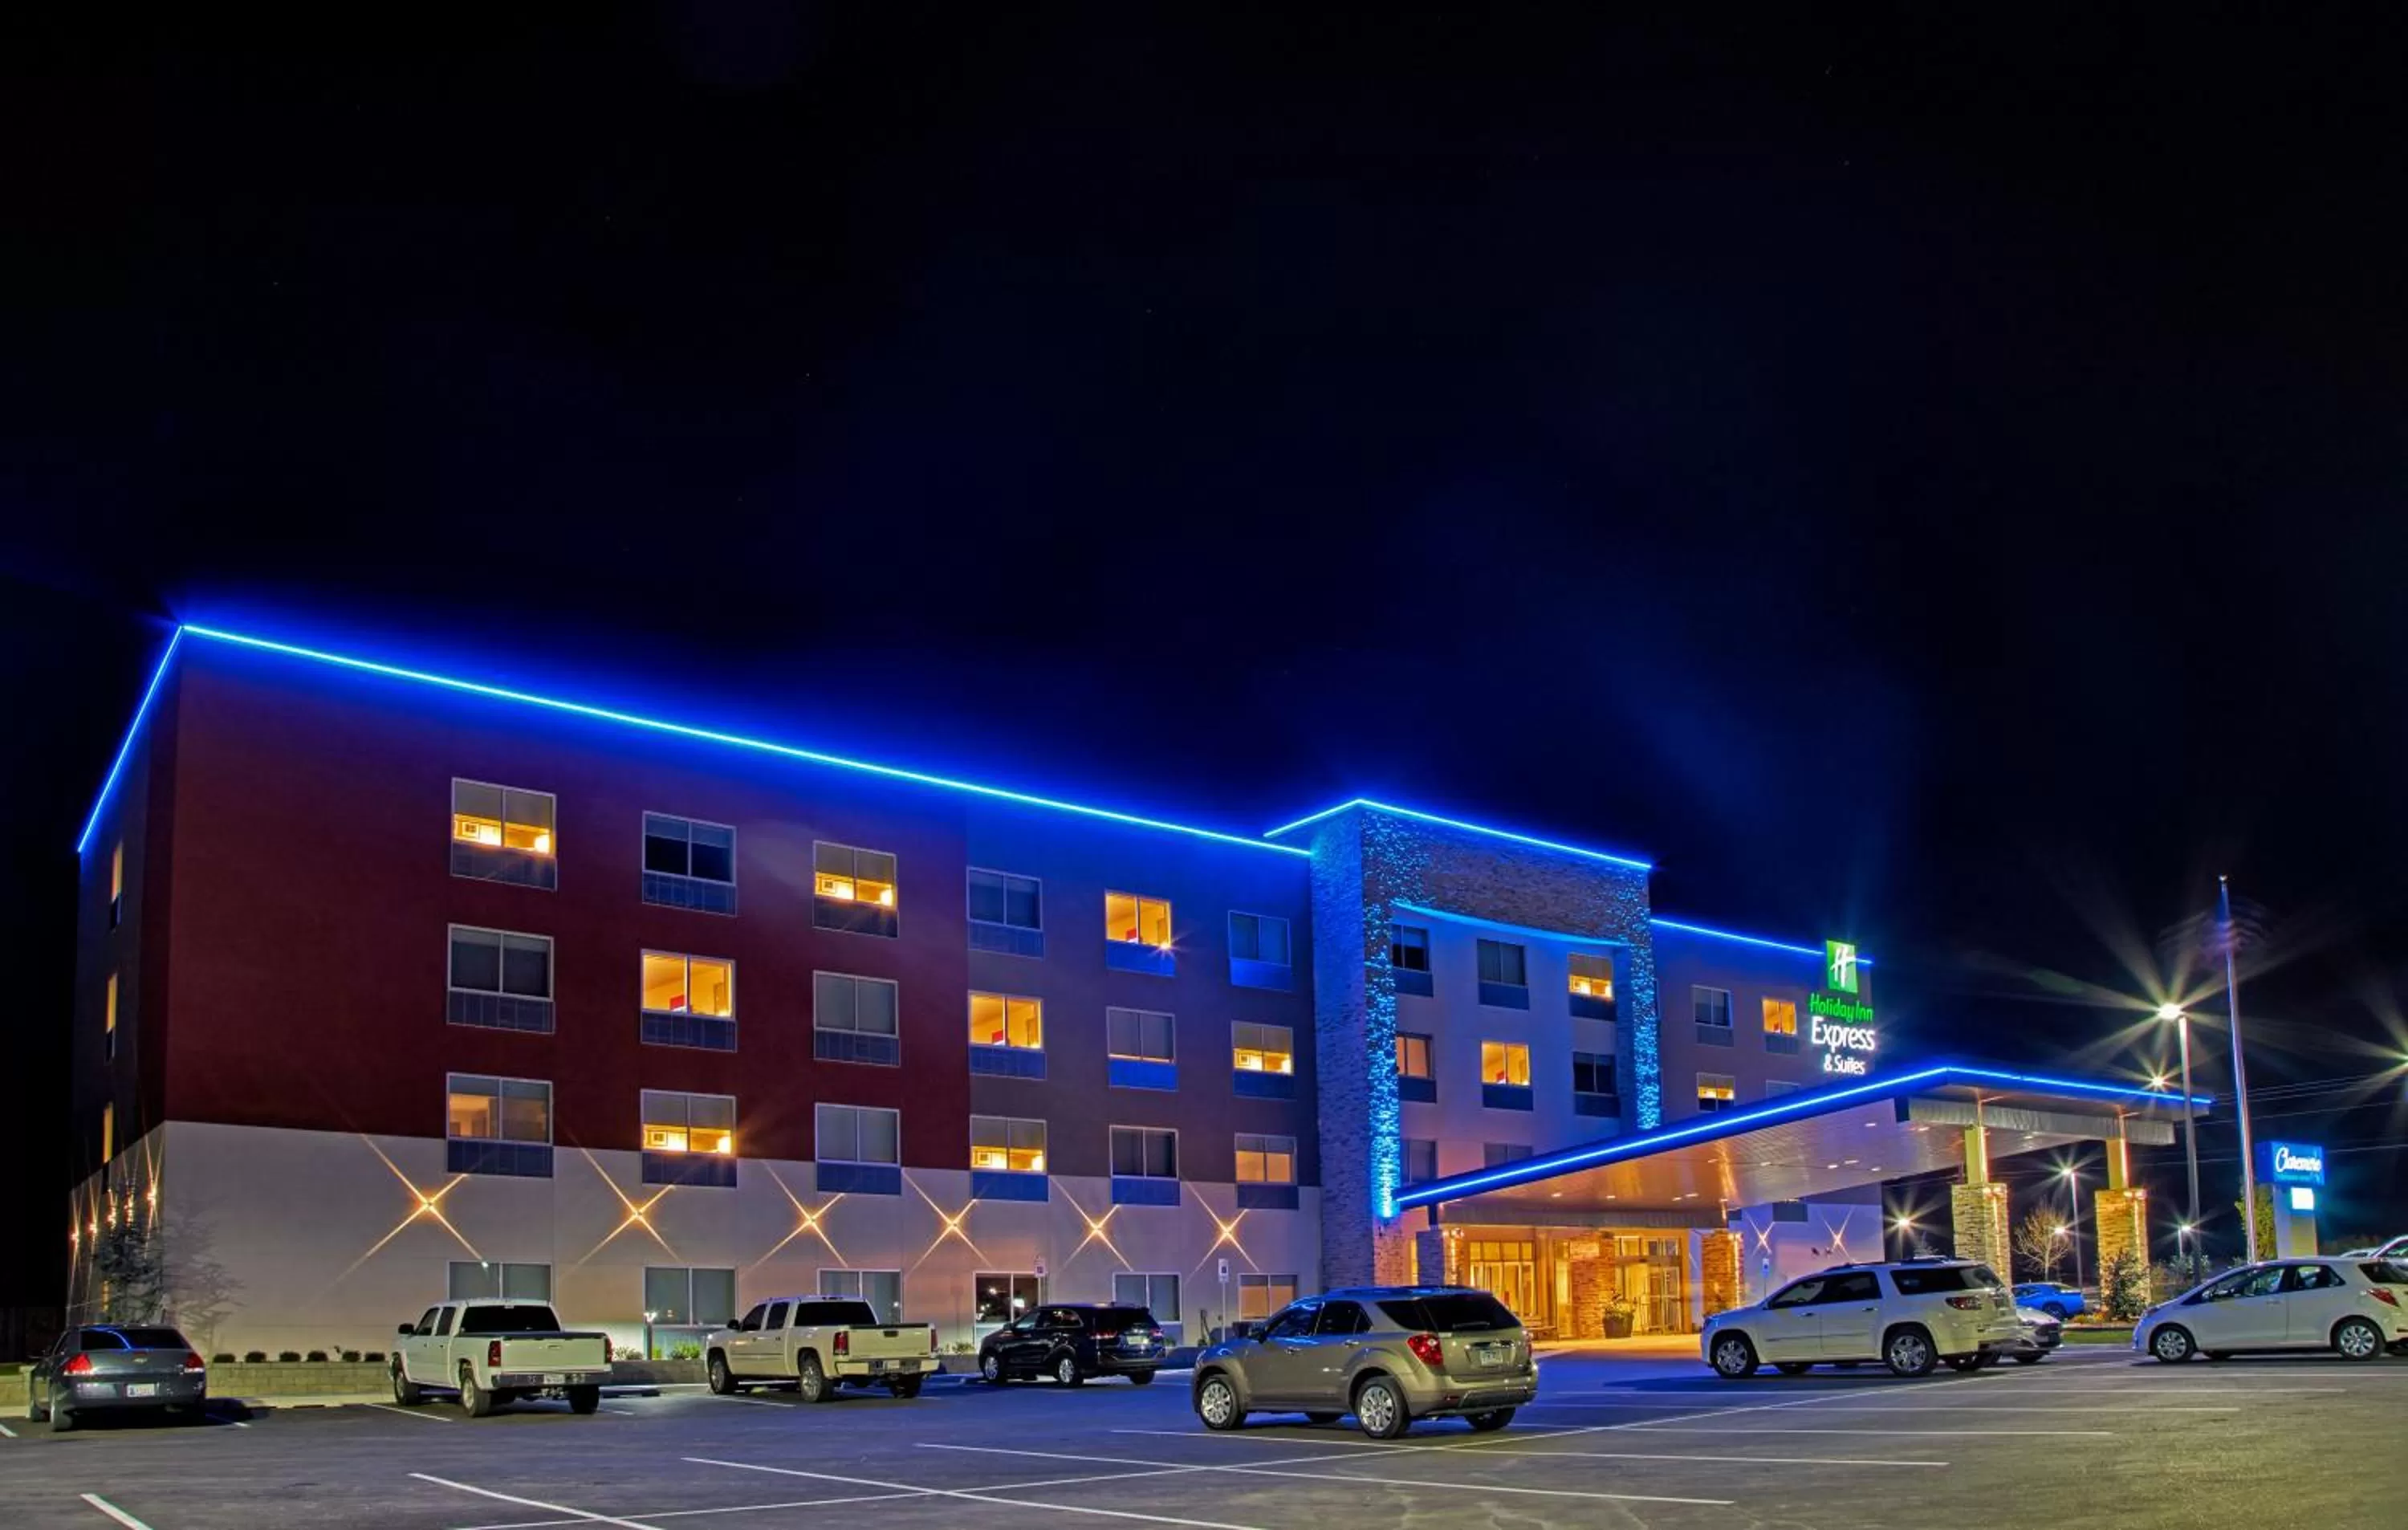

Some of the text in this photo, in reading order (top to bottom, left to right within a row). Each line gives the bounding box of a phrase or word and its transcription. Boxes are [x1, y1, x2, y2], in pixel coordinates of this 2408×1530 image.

[1810, 992, 1873, 1023] Holiday Inn
[1811, 1015, 1876, 1053] Express
[1824, 1053, 1865, 1075] & Suites
